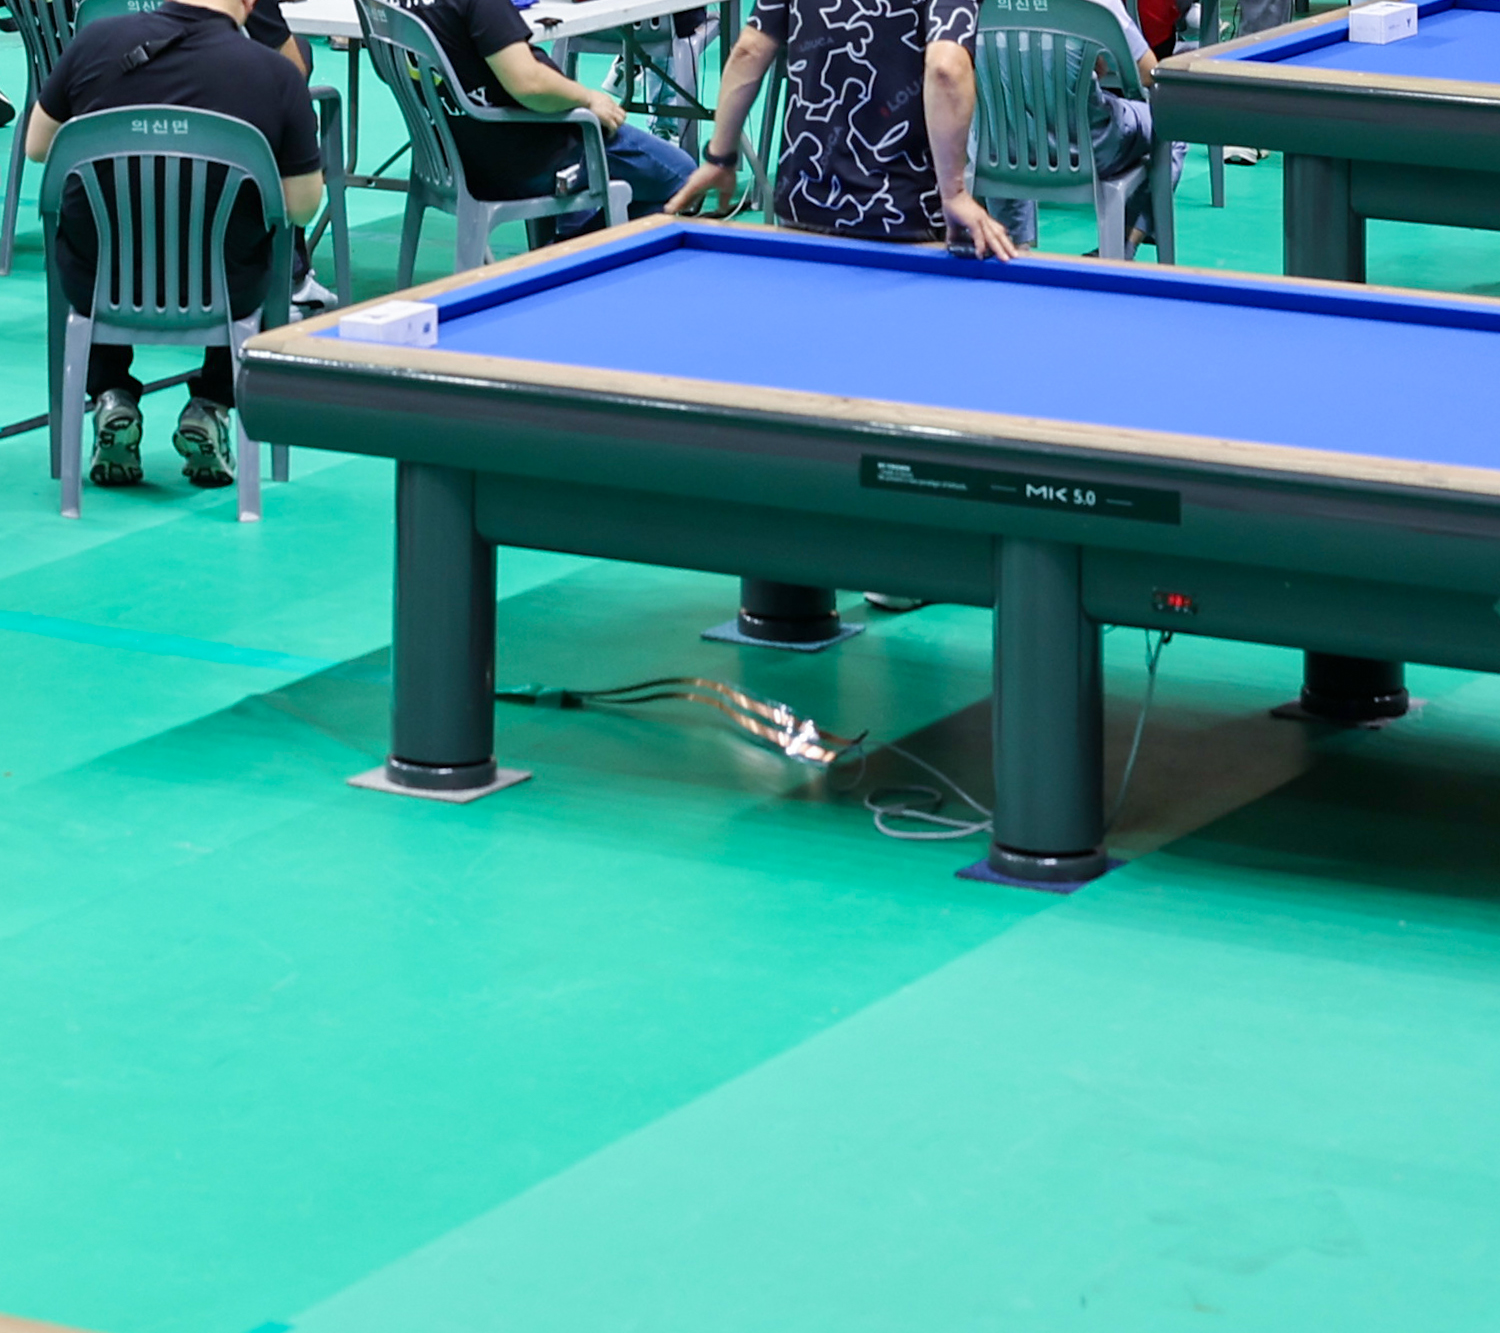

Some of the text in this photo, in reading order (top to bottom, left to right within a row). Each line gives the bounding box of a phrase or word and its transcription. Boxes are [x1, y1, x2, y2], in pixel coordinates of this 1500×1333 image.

[127, 0, 164, 14] 의신
[131, 118, 189, 135] 의신면
[1072, 488, 1097, 506] 5.0
